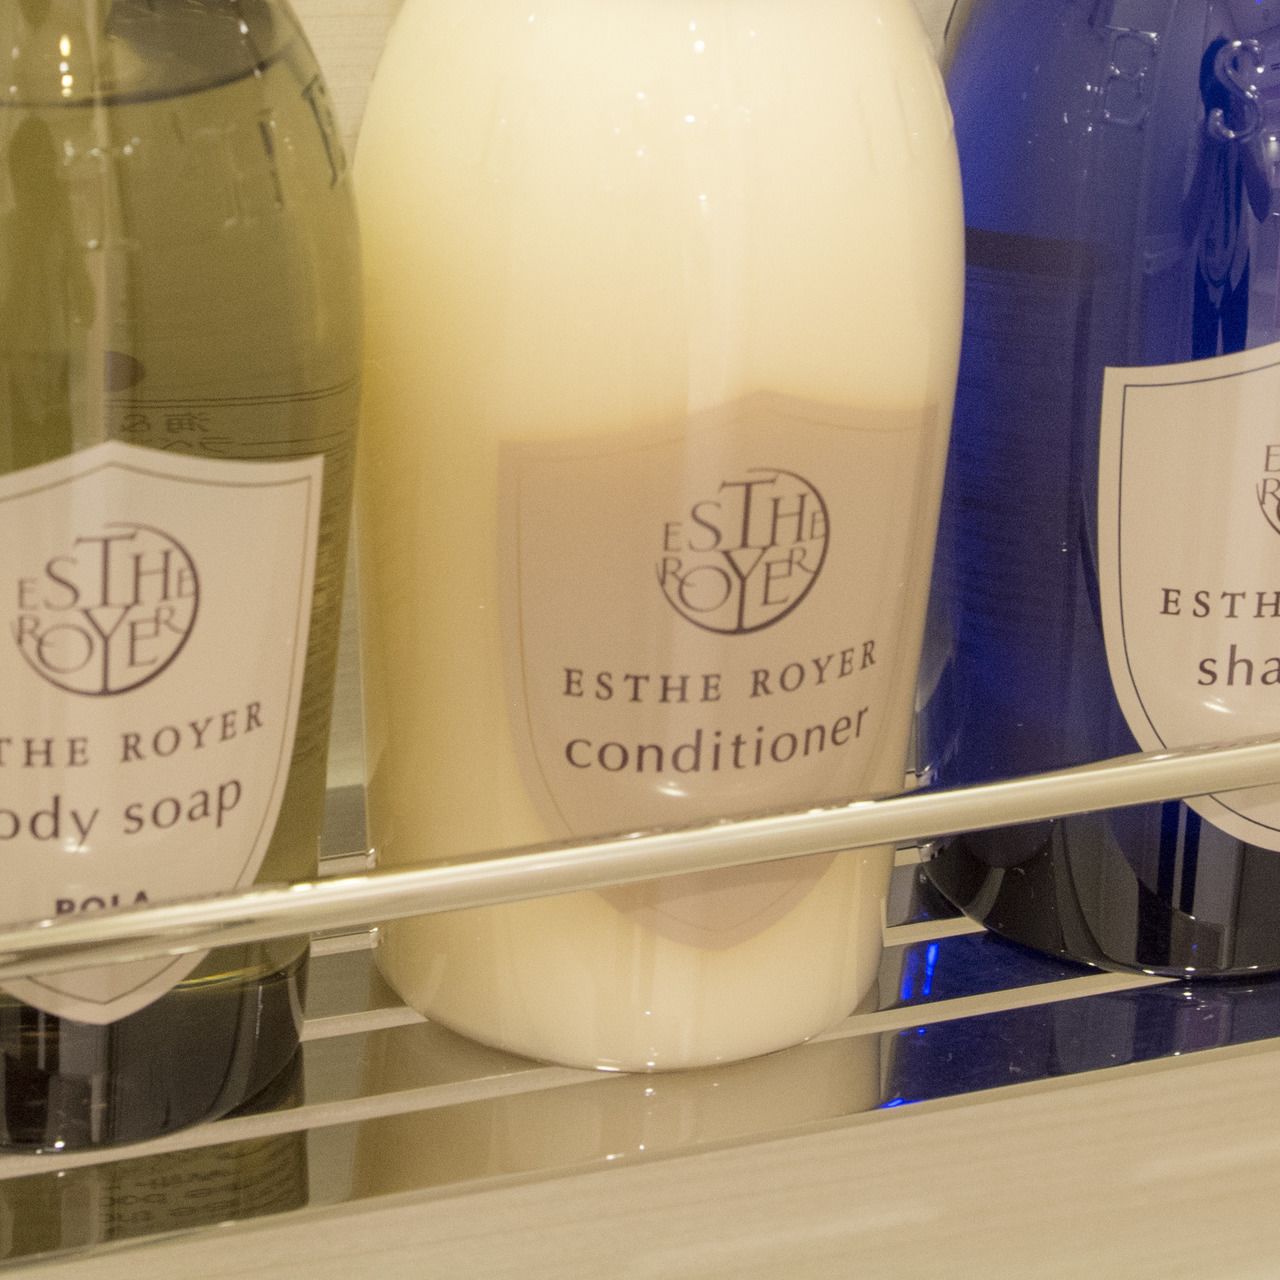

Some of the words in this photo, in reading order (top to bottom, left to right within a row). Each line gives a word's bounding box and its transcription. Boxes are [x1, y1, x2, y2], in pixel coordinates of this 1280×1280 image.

[563, 667, 722, 704] ESTHE
[749, 639, 876, 698] ROYER
[121, 701, 264, 763] ROYER
[566, 705, 869, 774] conditioner
[123, 777, 242, 836] soap
